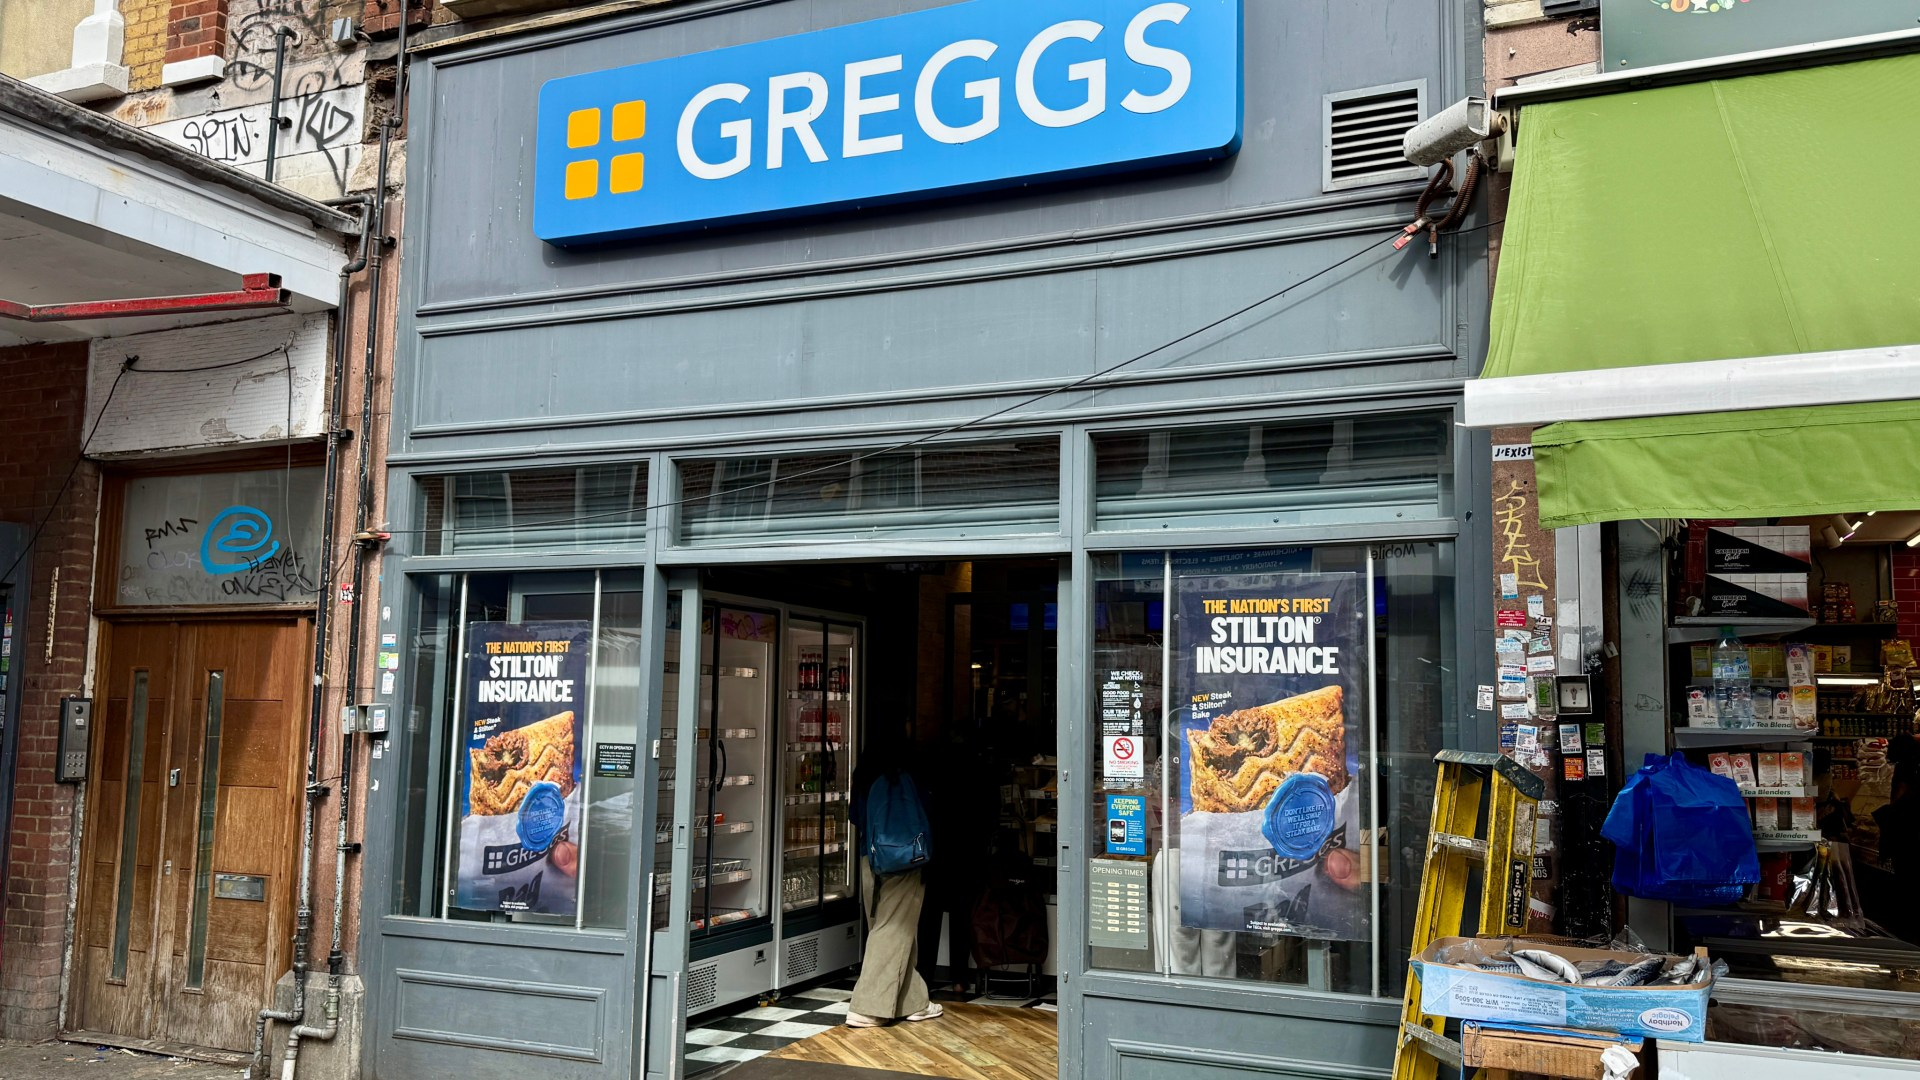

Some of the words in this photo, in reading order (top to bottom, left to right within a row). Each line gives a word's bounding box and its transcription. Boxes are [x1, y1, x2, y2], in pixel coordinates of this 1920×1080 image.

[676, 3, 1192, 179] GREGGS
[1203, 600, 1227, 614] THE
[1231, 599, 1289, 614] NATION'S
[1293, 598, 1331, 612] FIRST
[486, 642, 501, 654] THE
[503, 642, 542, 653] NATION'S
[544, 641, 570, 652] FIRST
[1196, 647, 1339, 674] INSURANCE
[479, 680, 574, 702] INSURANCE
[1192, 694, 1209, 702] NEW
[1210, 691, 1232, 700] Steak
[1455, 994, 1484, 1004] 300-500g
